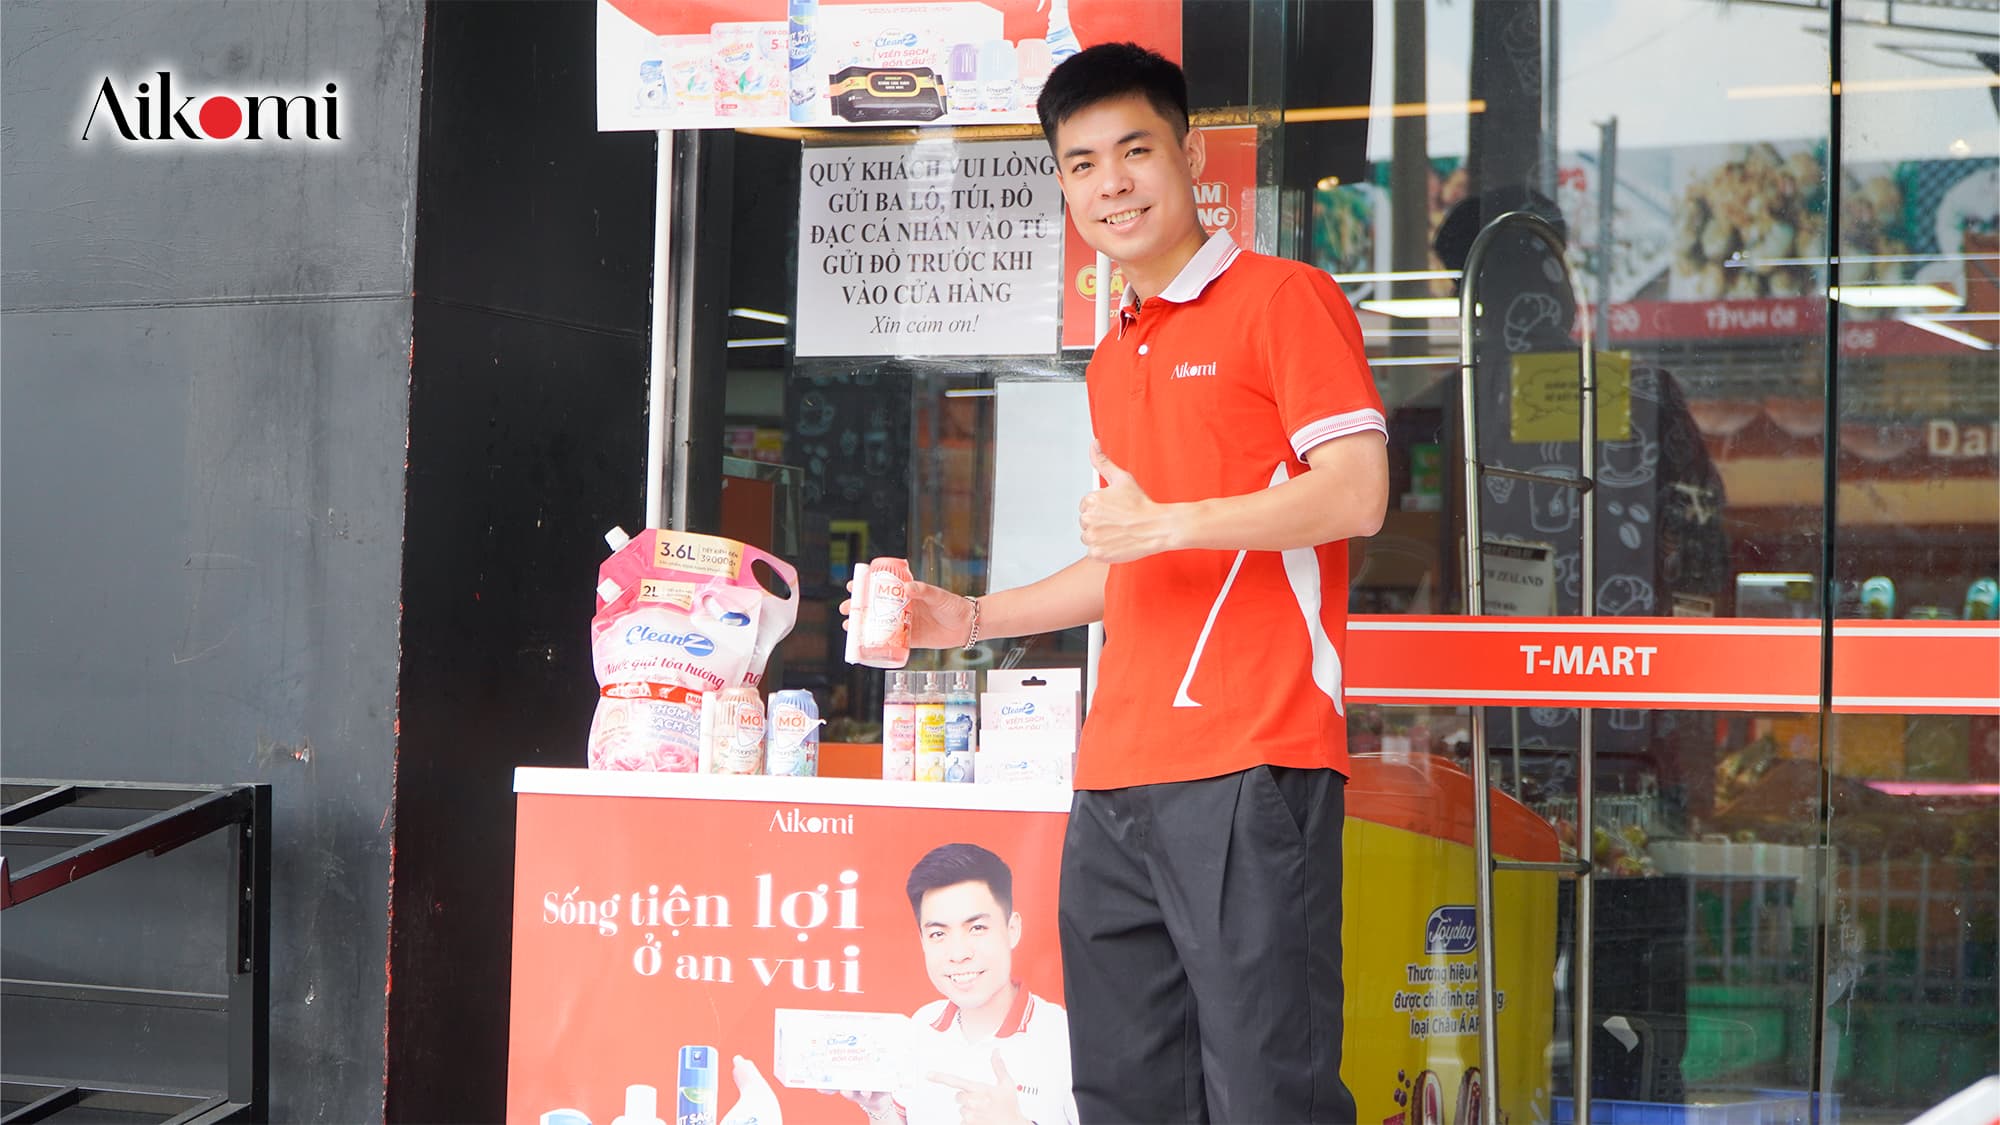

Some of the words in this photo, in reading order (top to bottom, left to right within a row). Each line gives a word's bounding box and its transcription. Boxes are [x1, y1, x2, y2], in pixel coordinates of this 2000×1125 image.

[809, 157, 855, 187] QUÝ
[861, 154, 941, 181] KHÁCH
[949, 158, 985, 178] VUI
[992, 150, 1055, 177] LÒNG
[828, 187, 869, 213] GỬI
[875, 192, 904, 212] BA
[951, 183, 995, 212] TÚI,
[1001, 182, 1034, 208] ĐỒ
[1197, 207, 1230, 226] NG
[811, 223, 856, 249] ĐẠC
[861, 217, 891, 242] CÁ
[897, 216, 959, 242] NHÂN
[966, 215, 1013, 240] VÀO
[1019, 212, 1049, 239] TỦ
[823, 250, 863, 274] GỬI
[869, 248, 901, 273] ĐỒ
[907, 247, 986, 273] TRƯỚC
[992, 250, 1033, 272] KHI
[842, 280, 888, 305] VÀO
[894, 279, 940, 304] CỬA
[948, 279, 1011, 304] HÀNG
[870, 315, 900, 334] Xin
[1170, 361, 1216, 380] Aikomi
[660, 541, 696, 561] 3.6L
[1519, 645, 1658, 676] T-MART
[778, 712, 806, 728] MỚI
[768, 808, 854, 834] Aikomi
[543, 885, 621, 937] Sống
[630, 884, 733, 937] tiện
[752, 869, 865, 943] lợi
[633, 932, 662, 976] Ở
[675, 953, 735, 984] an
[748, 944, 865, 994] vui
[1407, 964, 1447, 985] Thương
[1449, 963, 1471, 984] hiệu
[1394, 991, 1421, 1012] được
[1411, 1018, 1429, 1038] loại
[1432, 1017, 1457, 1033] Châu
[1459, 1012, 1466, 1032] Á
